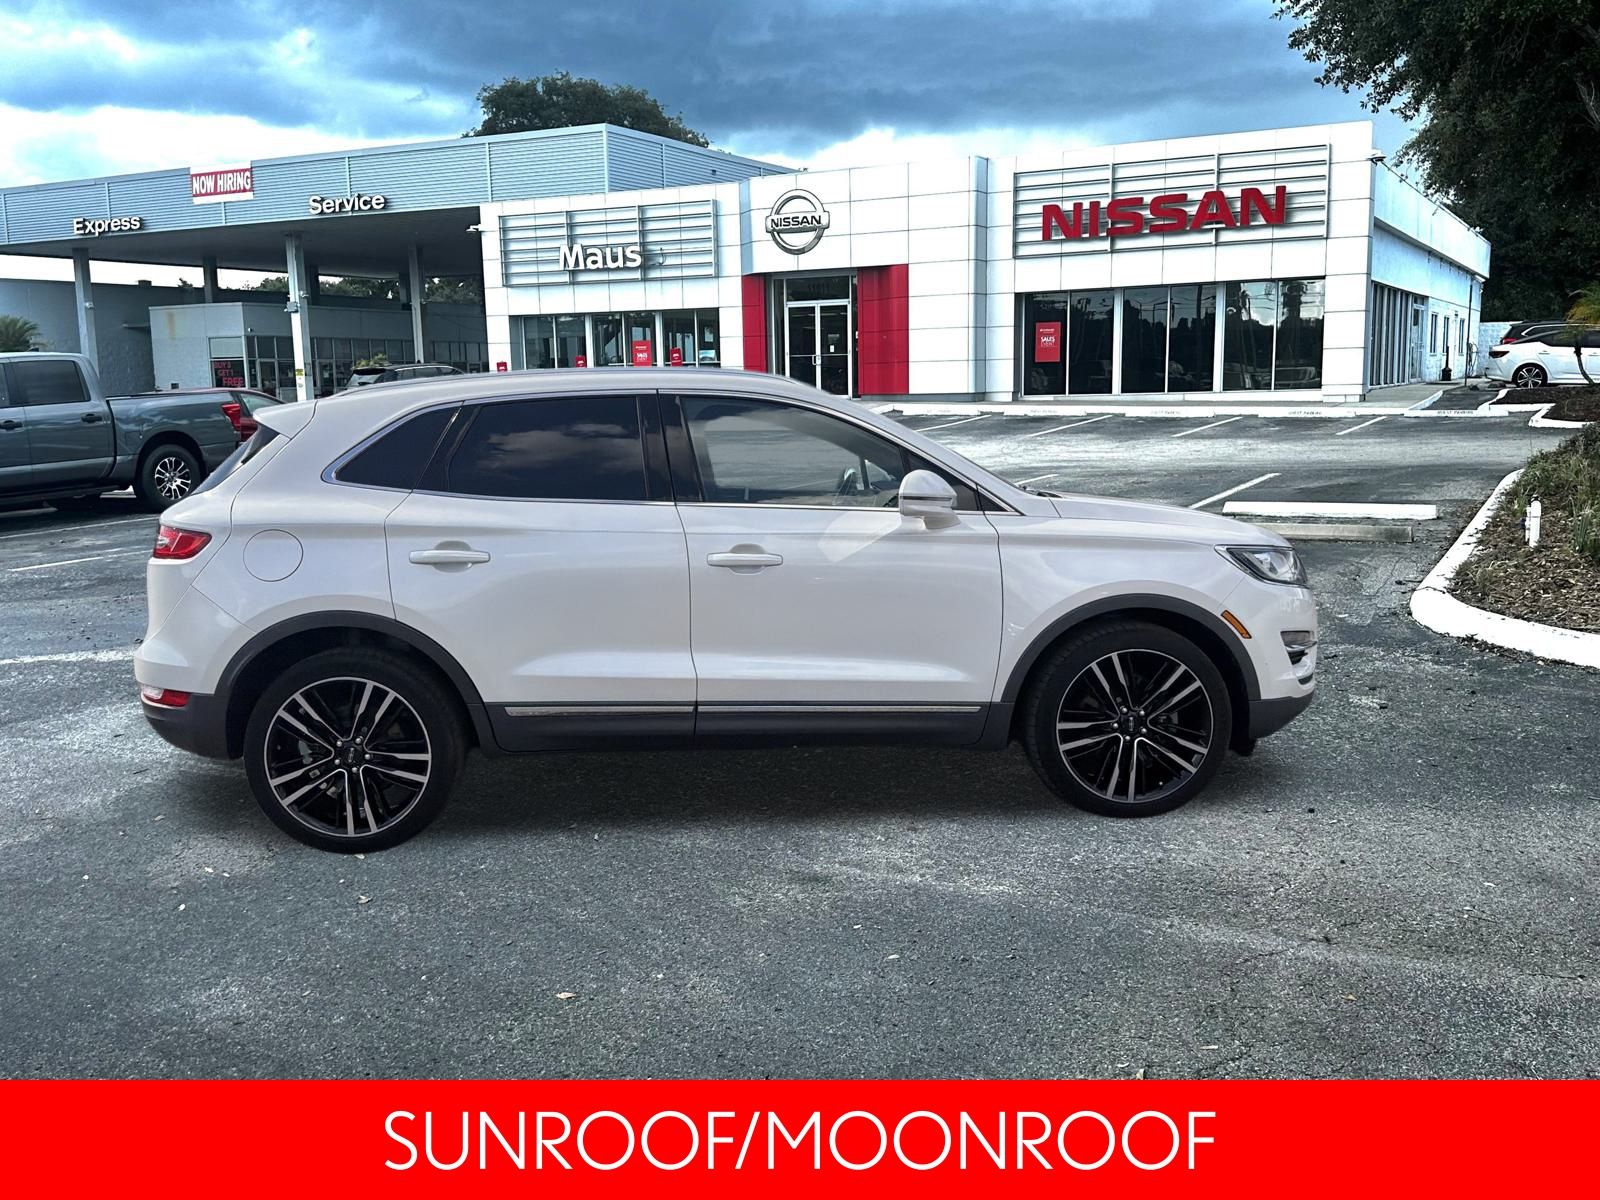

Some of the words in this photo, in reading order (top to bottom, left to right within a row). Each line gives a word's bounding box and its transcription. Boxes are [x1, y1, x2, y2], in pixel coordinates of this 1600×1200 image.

[192, 174, 215, 195] NOW
[217, 171, 251, 193] HIRING
[309, 193, 385, 215] Service
[1043, 185, 1286, 241] NISSAN
[73, 216, 141, 236] Express
[770, 215, 822, 228] NISSAN
[559, 243, 642, 271] Maus
[223, 377, 244, 387] FREE
